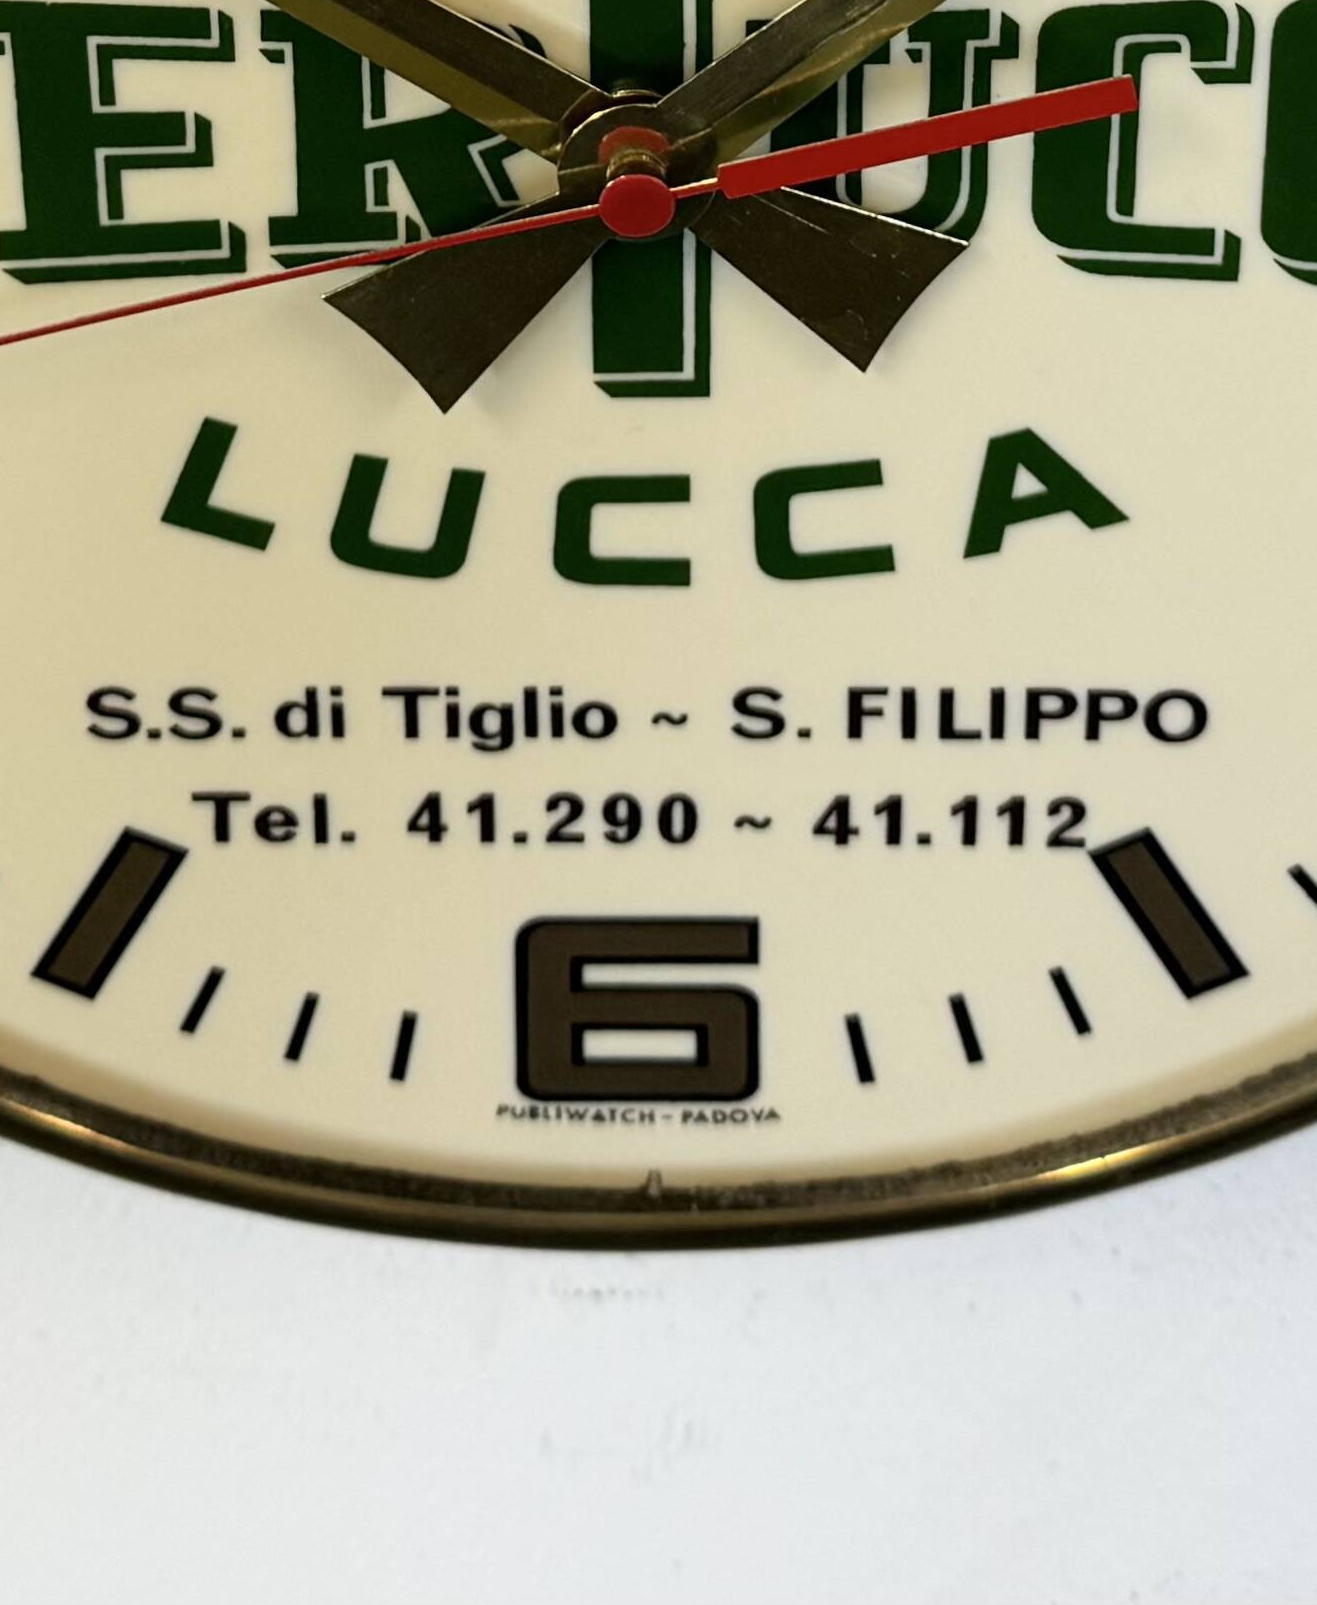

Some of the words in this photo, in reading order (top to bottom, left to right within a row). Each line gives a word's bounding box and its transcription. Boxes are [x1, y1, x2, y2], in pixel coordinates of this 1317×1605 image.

[160, 425, 1130, 587] LUCCA
[84, 686, 247, 742] S.S.
[273, 686, 346, 740] di
[381, 686, 620, 753] Tiglio
[731, 686, 814, 741] S.
[846, 686, 1210, 744] FILIPPO
[192, 791, 357, 845] Tel.
[406, 792, 700, 846] 41.290
[812, 794, 1088, 849] 41.112
[514, 915, 761, 1102] 6
[495, 1103, 656, 1125] PUBLIWATCH
[680, 1106, 781, 1126] PADOVA
